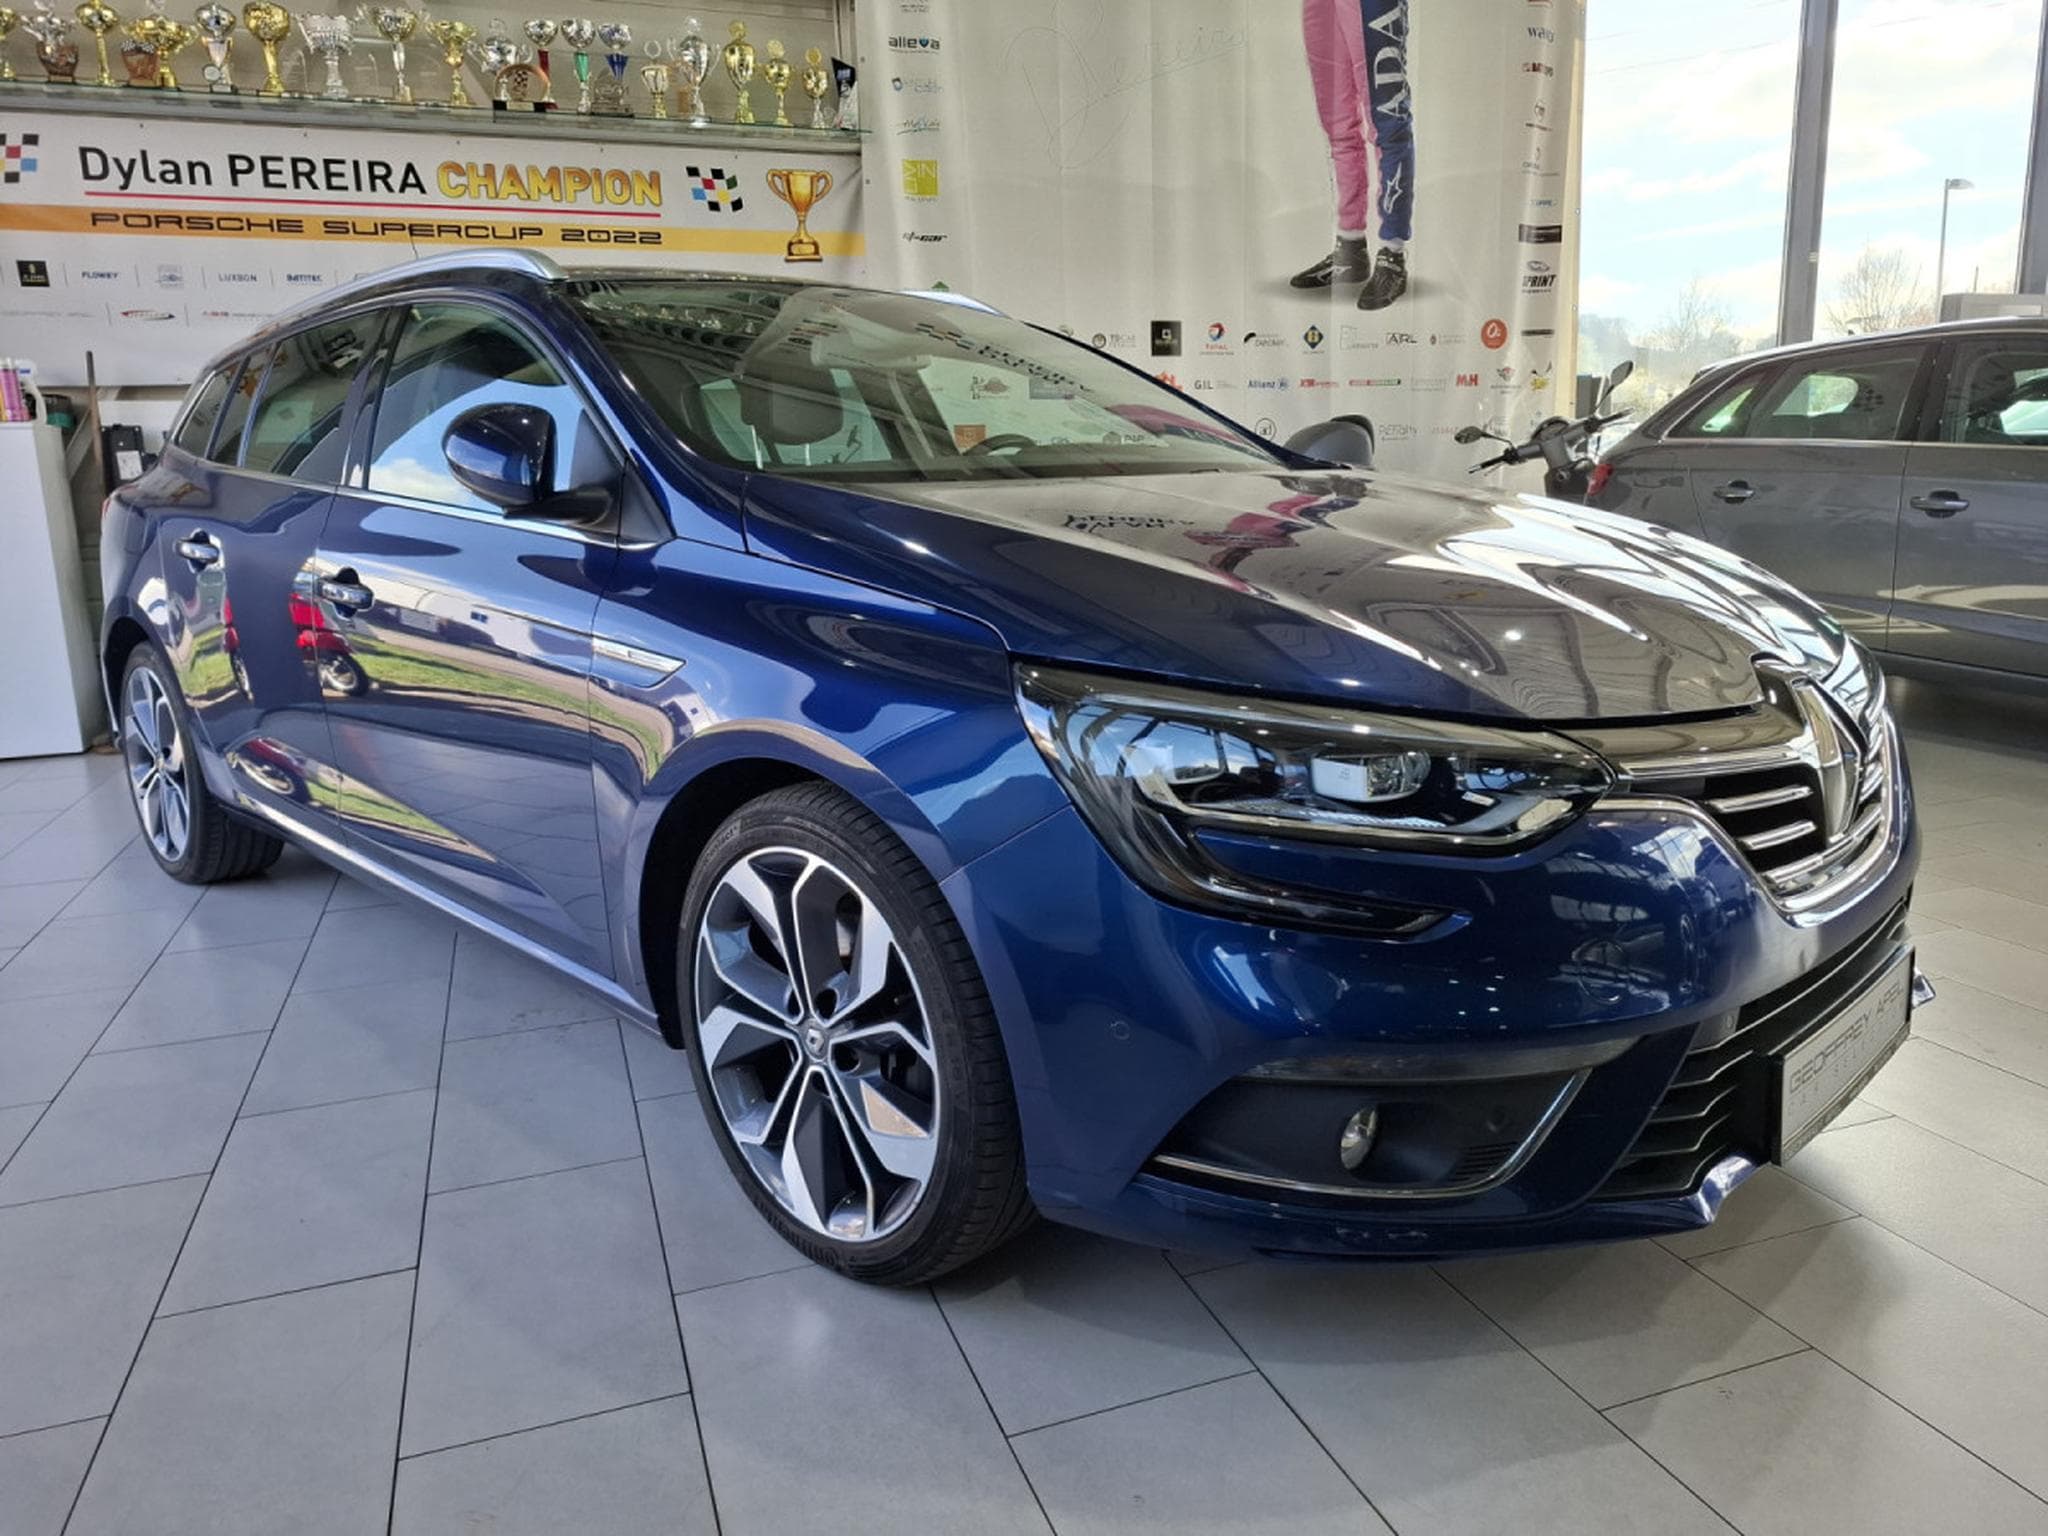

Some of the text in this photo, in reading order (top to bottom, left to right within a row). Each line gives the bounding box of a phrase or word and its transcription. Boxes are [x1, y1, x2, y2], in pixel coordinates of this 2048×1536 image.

[78, 146, 663, 206] Dylan PEREIRA CHAMPION
[91, 212, 663, 245] PORSCHE SUPERCUP 2022
[1194, 379, 1213, 390] GIL
[1248, 379, 1276, 389] Allianz
